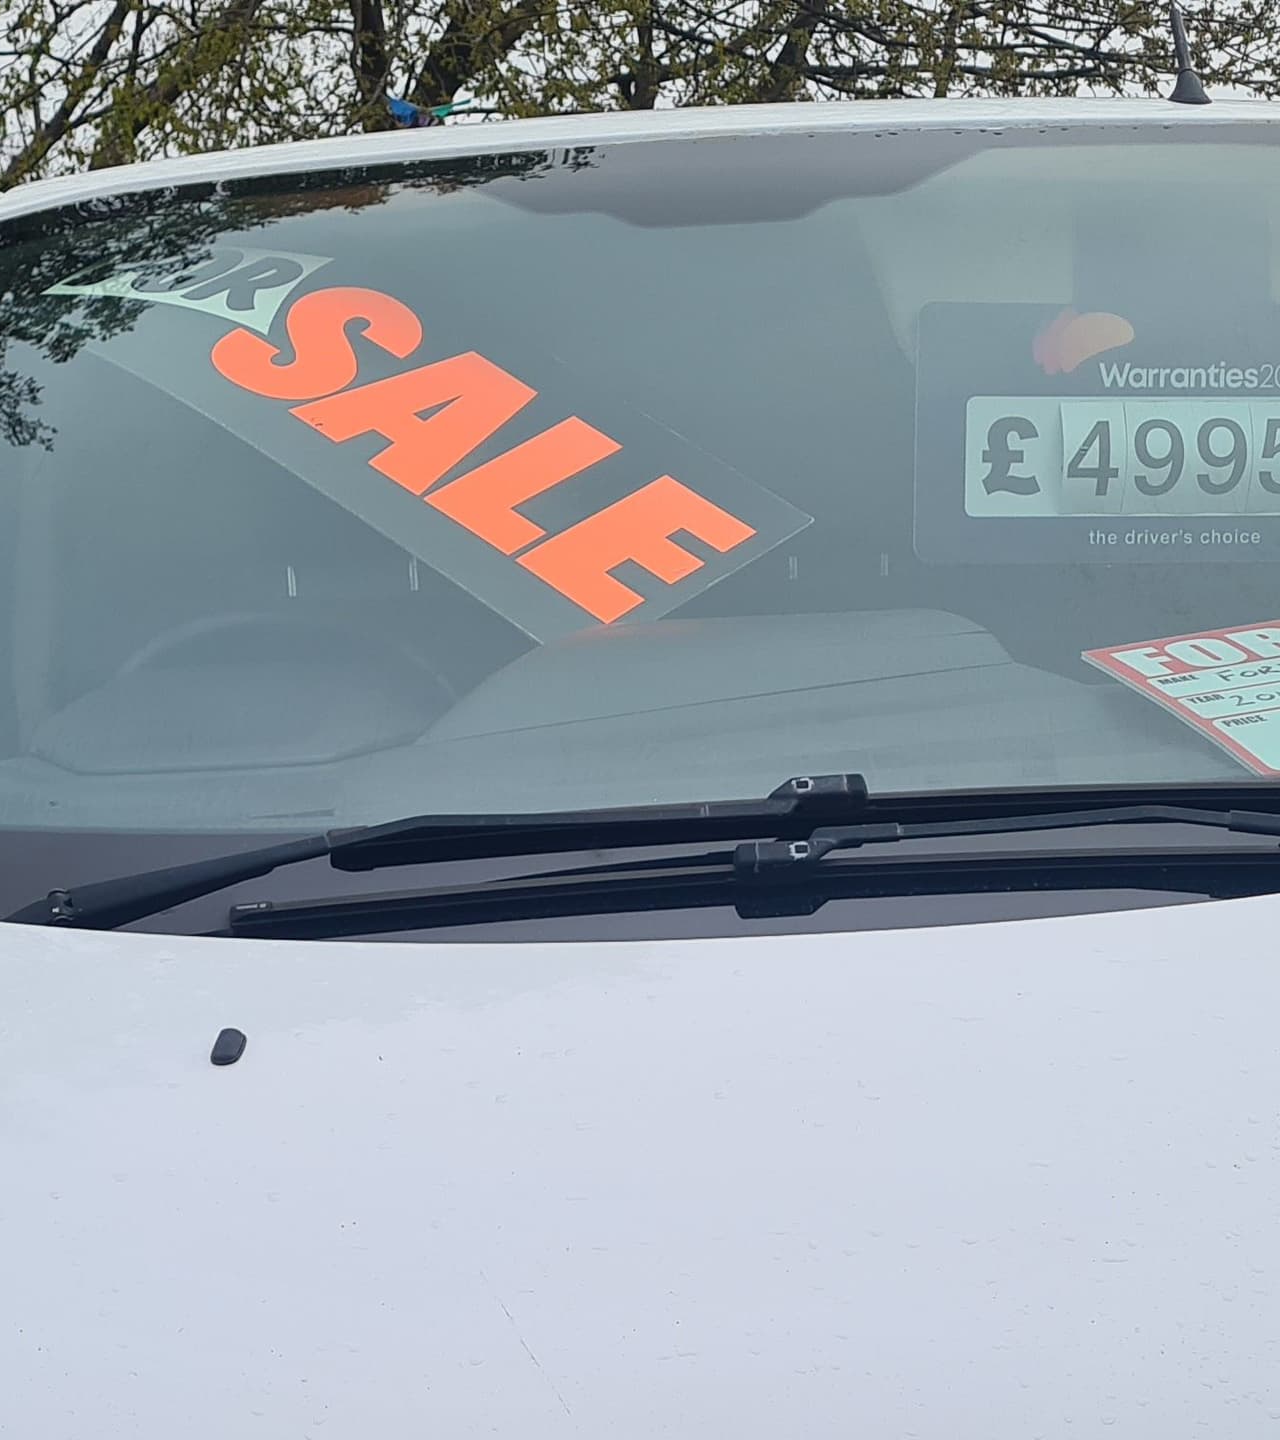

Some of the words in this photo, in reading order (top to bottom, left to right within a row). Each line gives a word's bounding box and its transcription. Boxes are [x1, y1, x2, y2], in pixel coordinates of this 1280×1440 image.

[210, 286, 758, 626] SALE
[1088, 529, 1118, 545] the
[1124, 529, 1193, 545] driver's
[1200, 529, 1261, 544] choice
[1157, 674, 1200, 686] MAKE
[1186, 693, 1225, 705] YEAR
[1222, 714, 1268, 728] PRICE
